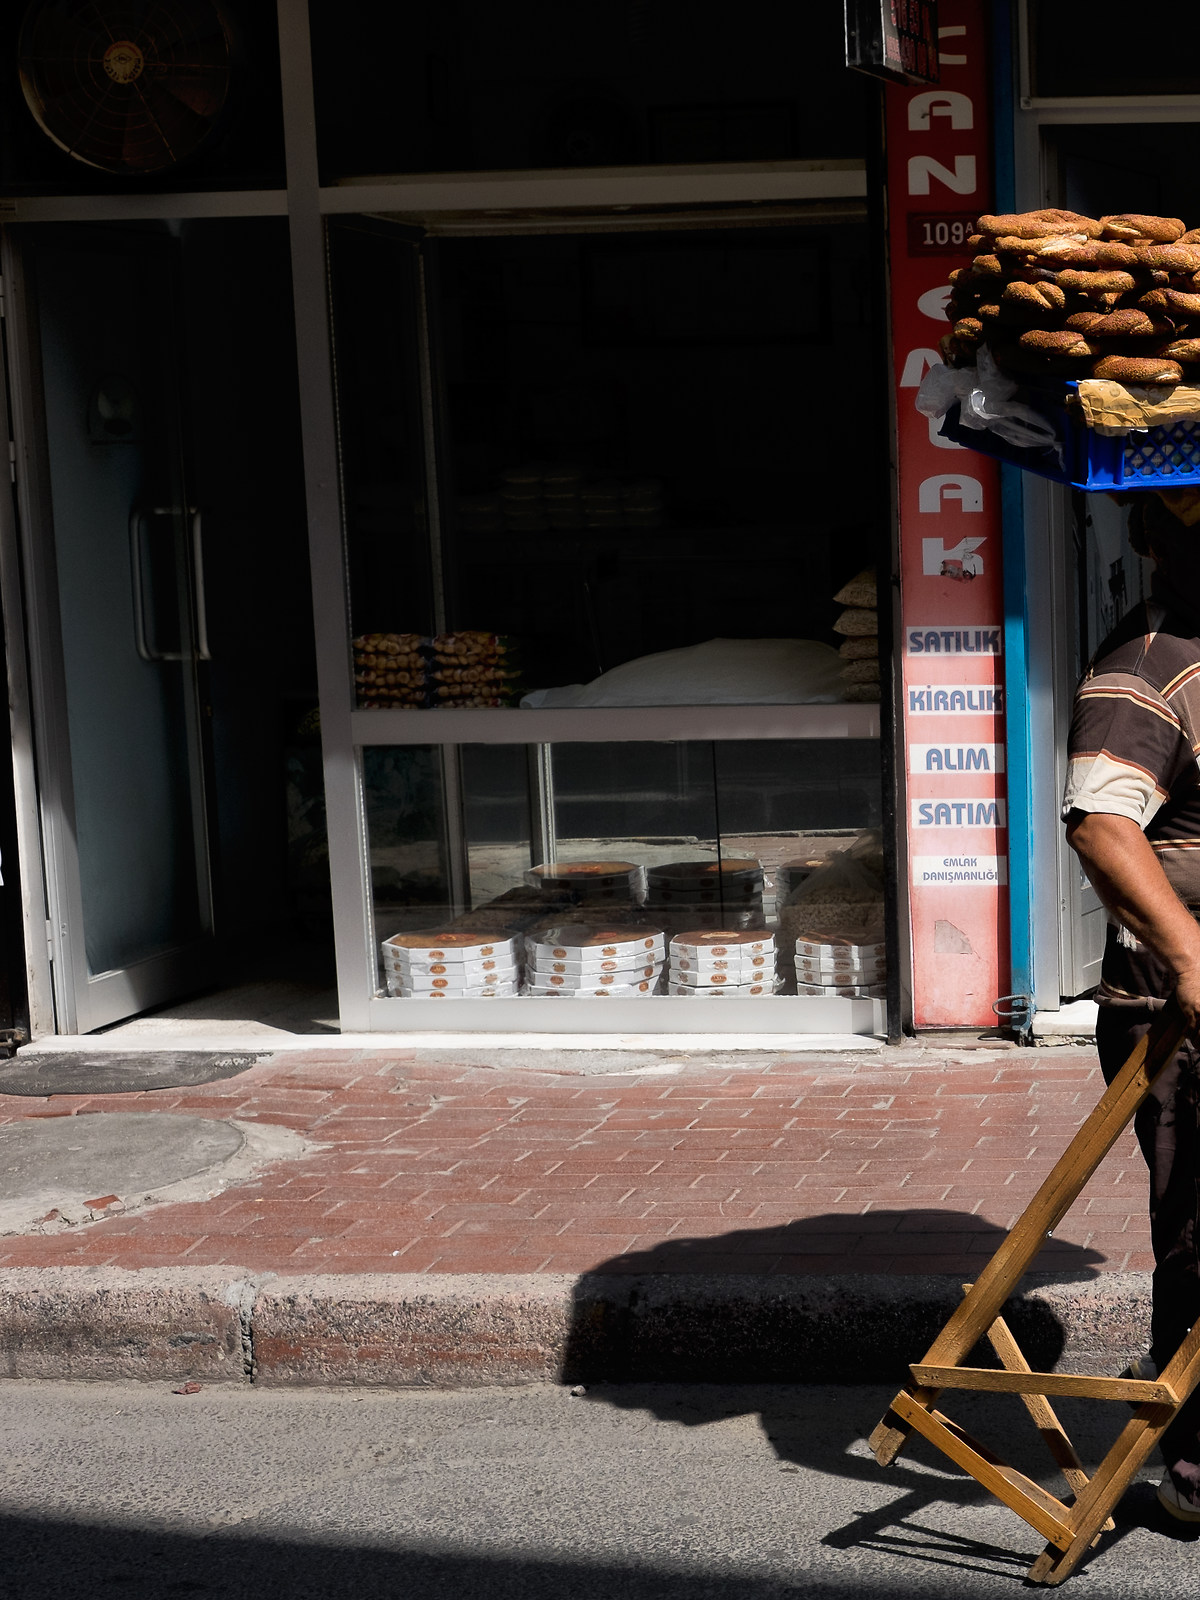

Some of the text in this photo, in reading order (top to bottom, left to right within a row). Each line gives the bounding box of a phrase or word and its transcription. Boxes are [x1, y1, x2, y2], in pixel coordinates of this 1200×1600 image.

[909, 630, 1000, 654] SATILIK
[909, 684, 1002, 712] KİRALIK
[925, 748, 991, 771] ALIM
[918, 802, 1000, 826] SATIM
[942, 857, 978, 868] EMLAK
[922, 868, 999, 884] DANIŞMANLIĞI
